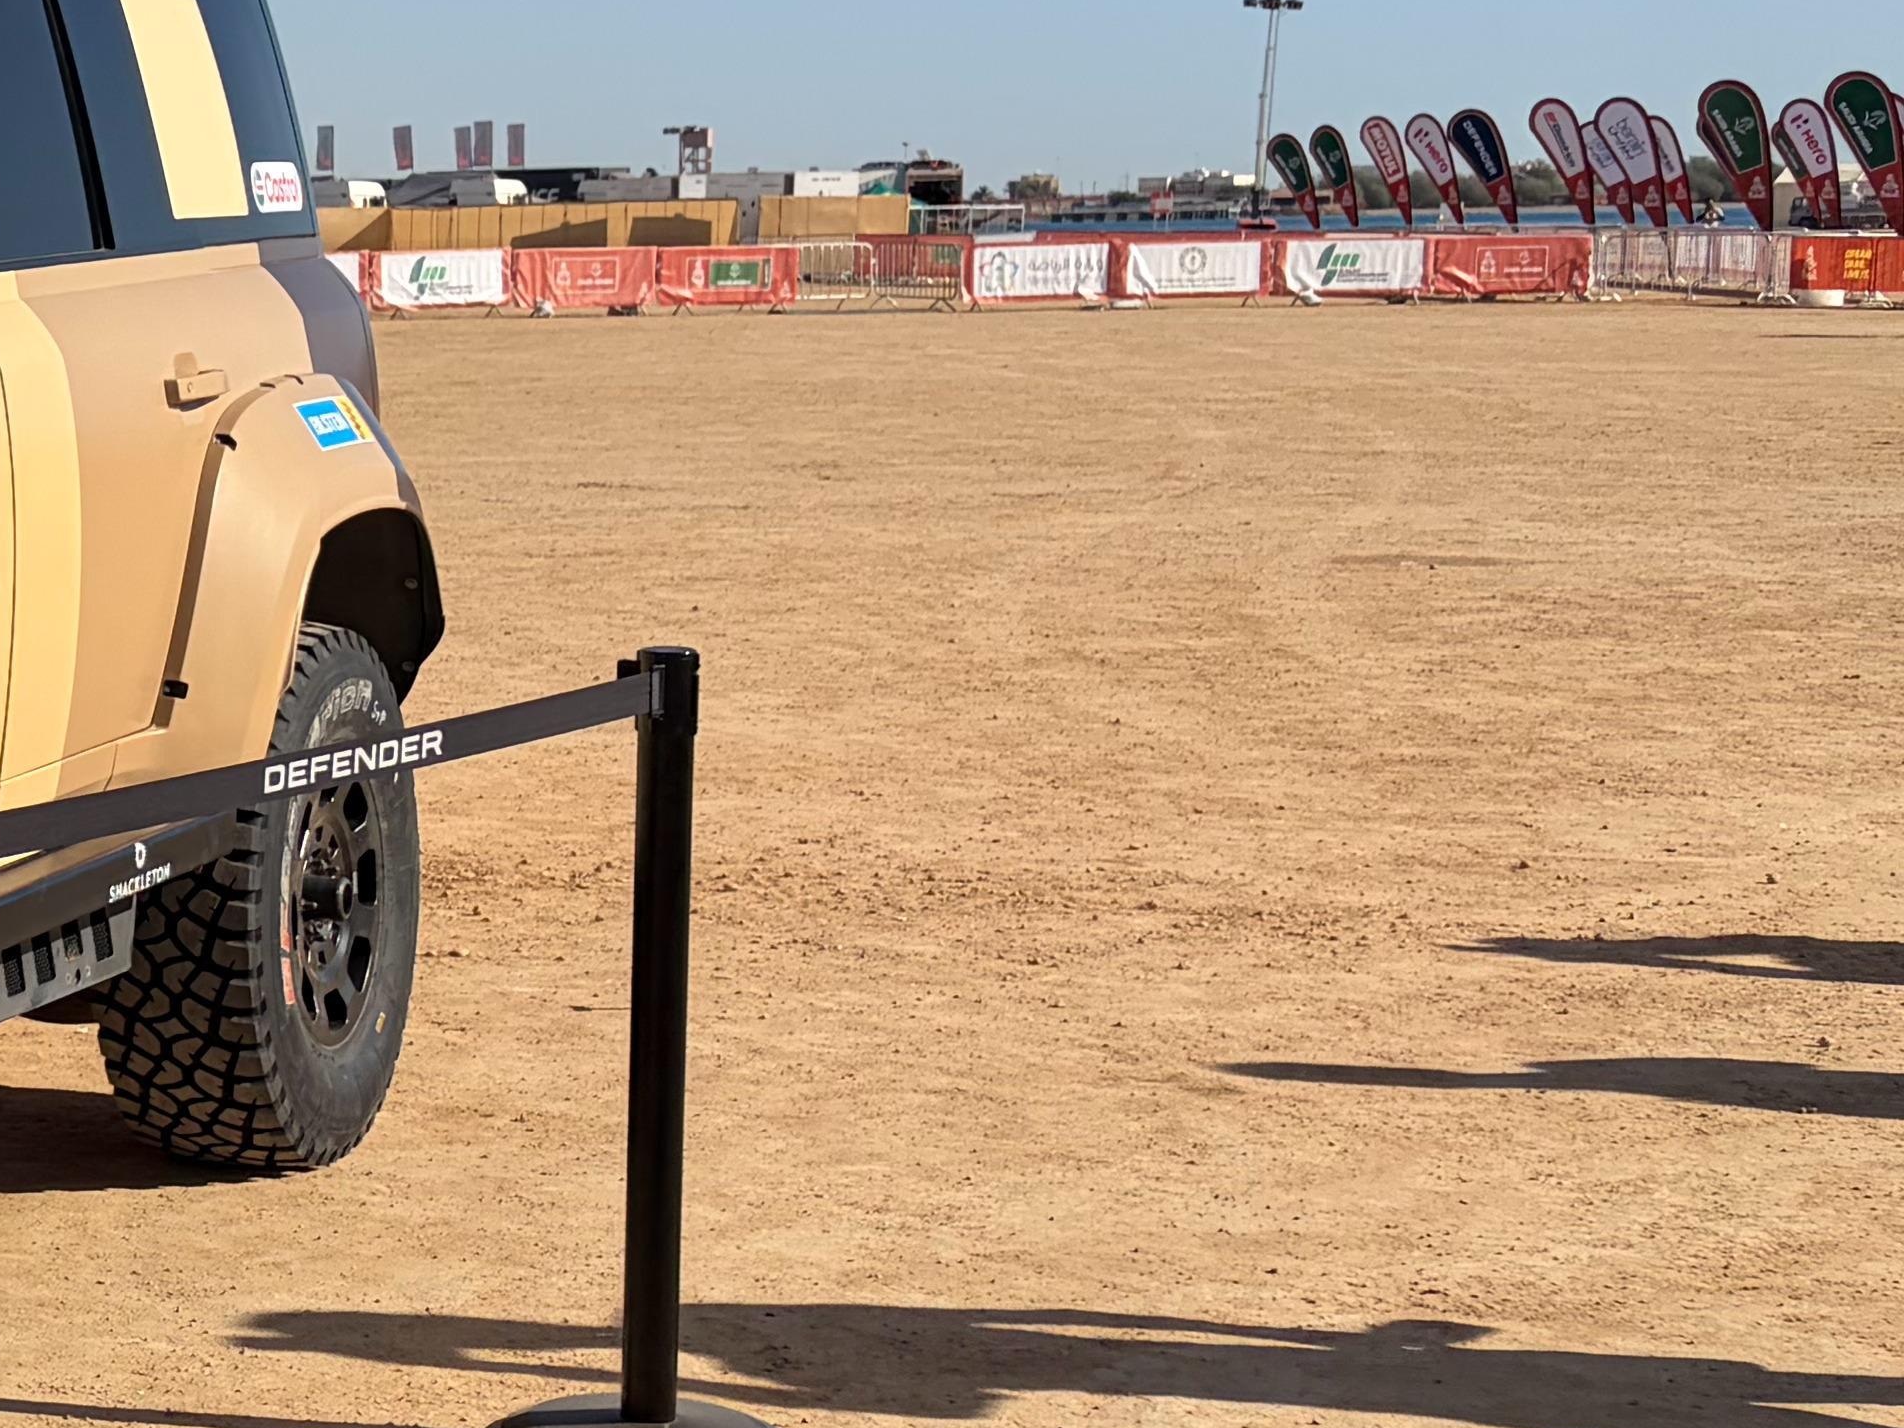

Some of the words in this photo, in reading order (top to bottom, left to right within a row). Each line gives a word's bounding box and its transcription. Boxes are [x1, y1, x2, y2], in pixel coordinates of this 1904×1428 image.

[1370, 124, 1400, 176] MOTUL
[1463, 120, 1499, 177] DEFENDER
[264, 729, 444, 795] DEFENDER
[109, 862, 171, 904] SHACKLETON
